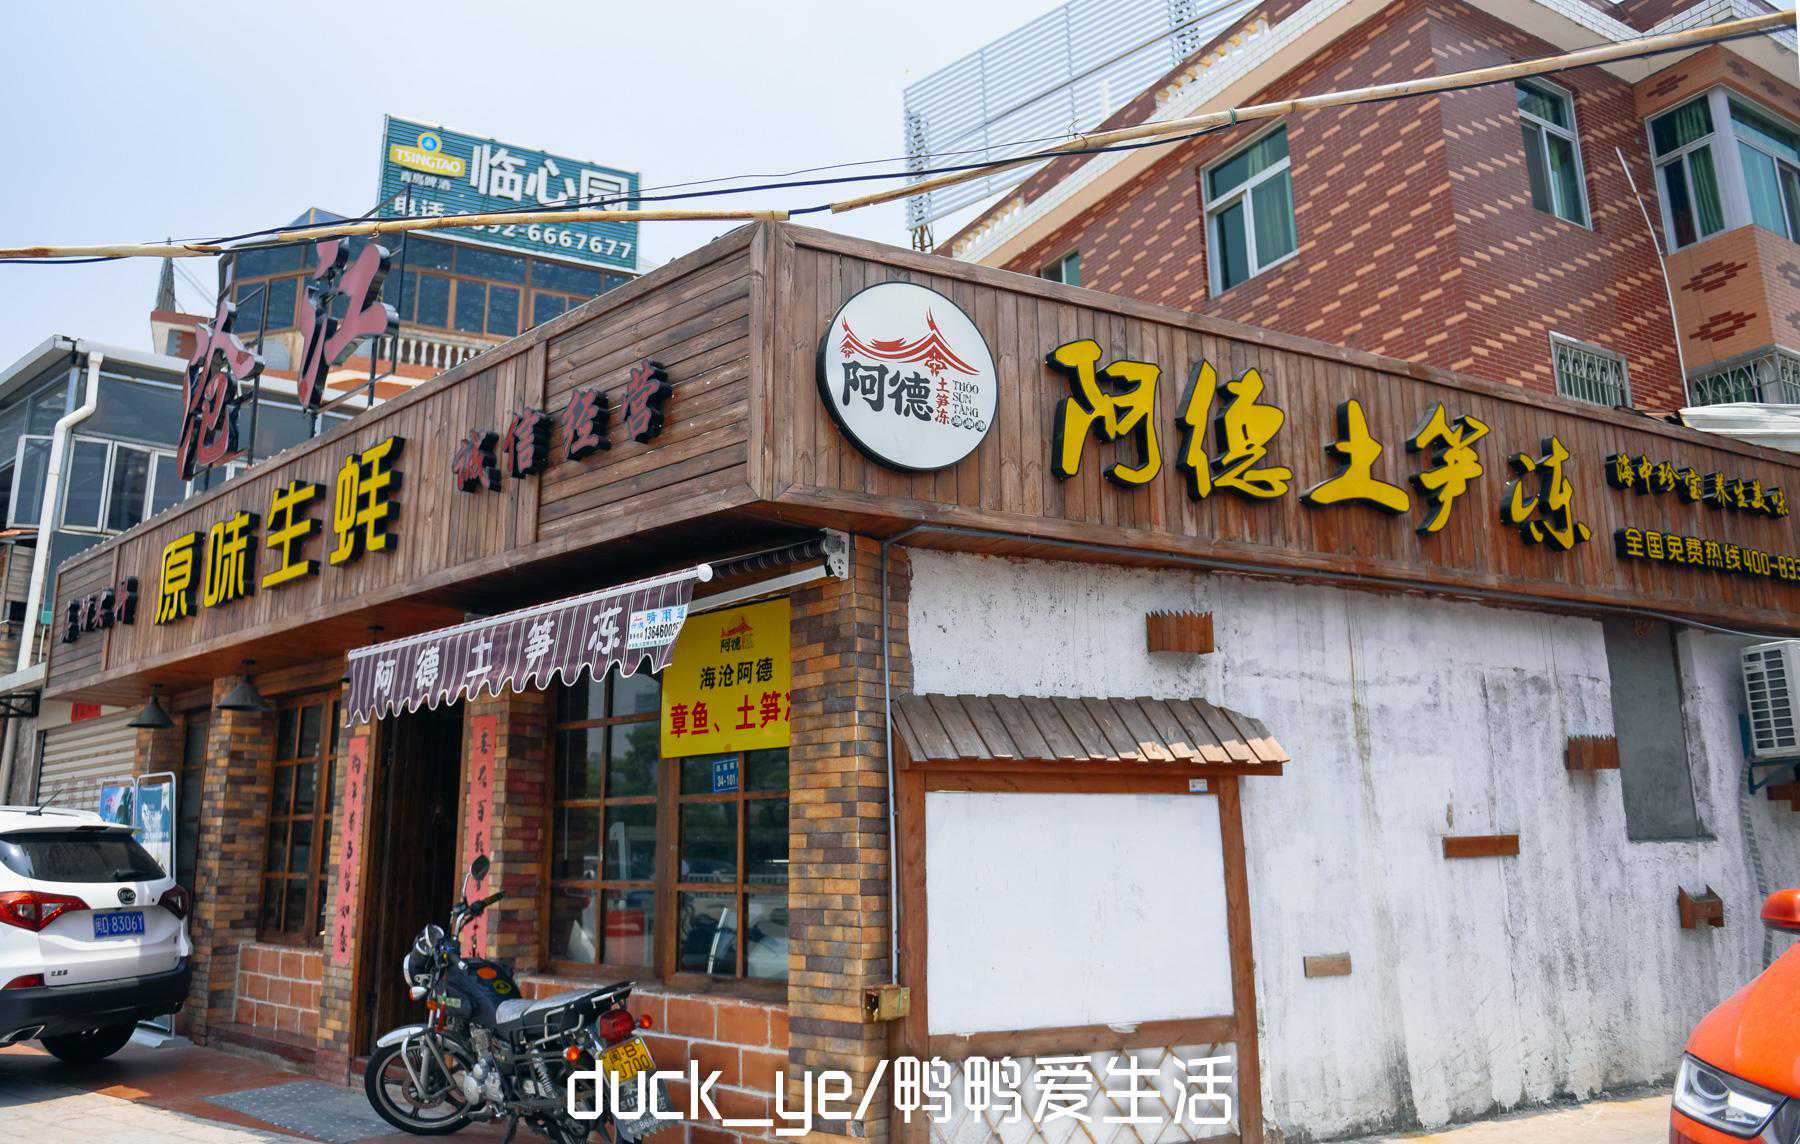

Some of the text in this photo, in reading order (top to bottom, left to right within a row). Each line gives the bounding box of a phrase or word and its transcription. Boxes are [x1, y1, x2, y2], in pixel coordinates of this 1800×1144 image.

[396, 149, 462, 173] TSINGTAO
[842, 361, 934, 421] 阿德
[936, 377, 949, 425] 土笋冻
[1047, 339, 1592, 551] 阿德土笋冻
[154, 436, 396, 625] 原味生蚝
[374, 606, 622, 699] 阿德土笋冻
[700, 657, 773, 690] 海沧阿德
[670, 690, 791, 738] 章鱼、土笋
